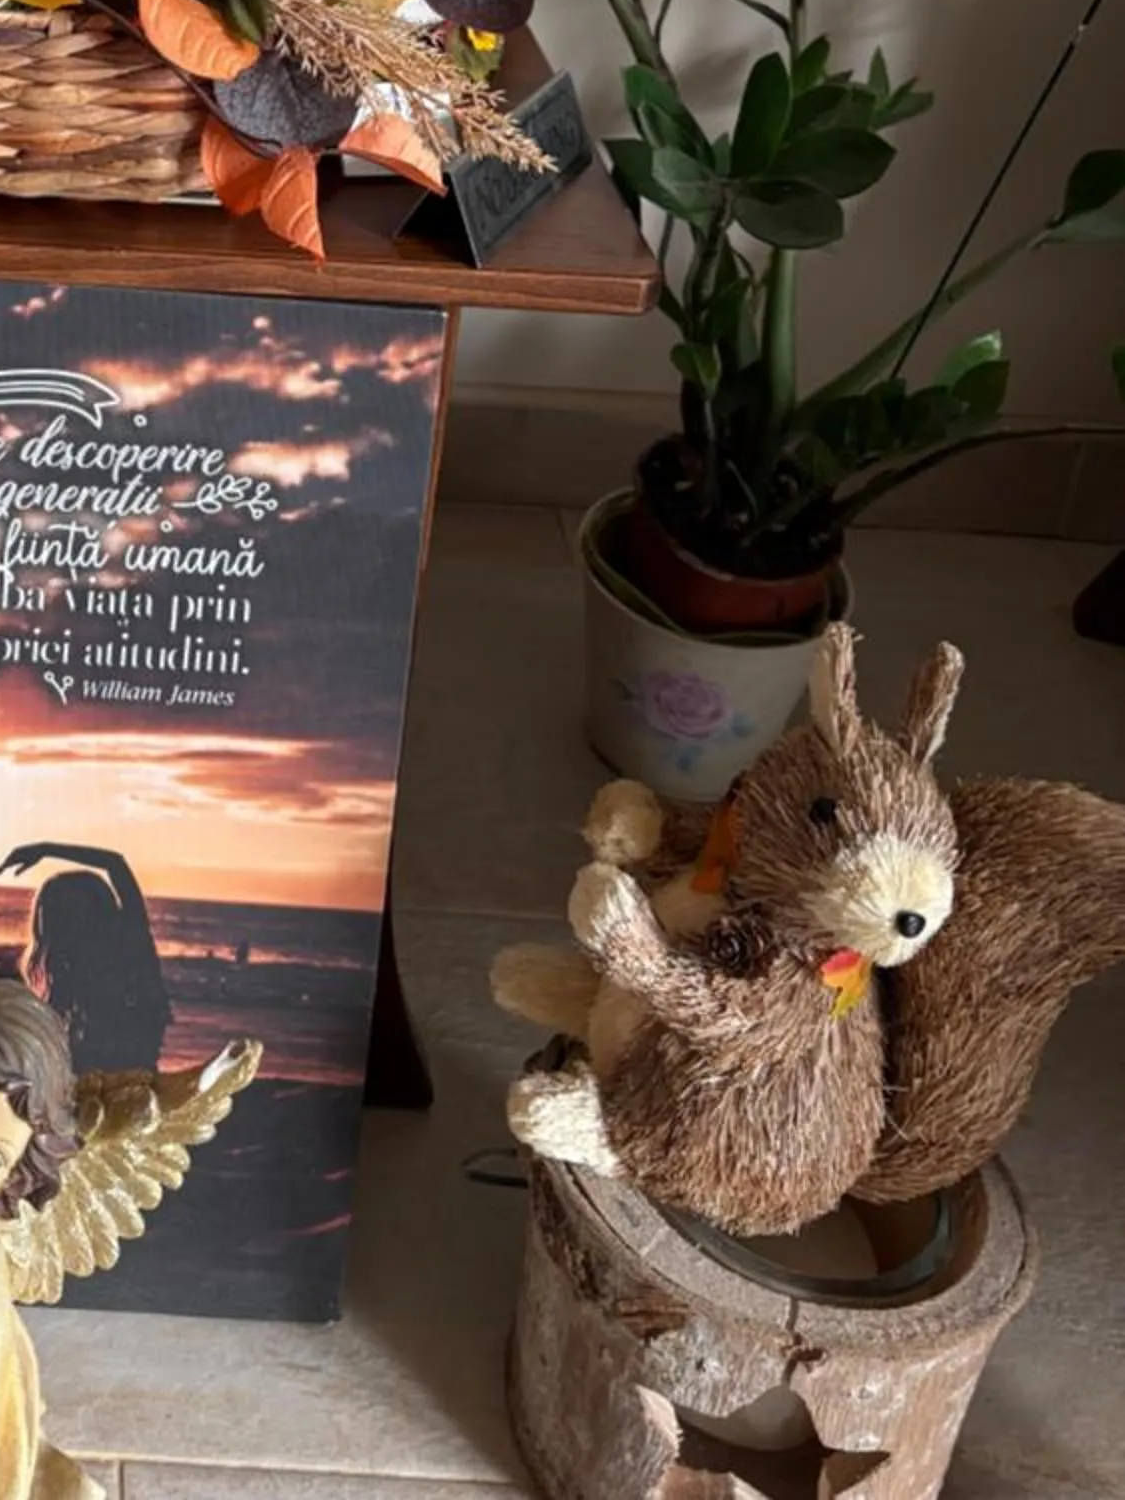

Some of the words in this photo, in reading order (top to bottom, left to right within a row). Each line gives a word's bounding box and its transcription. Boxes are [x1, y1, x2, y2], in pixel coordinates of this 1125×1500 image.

[19, 413, 226, 484] descoperire
[125, 537, 265, 578] umană
[169, 583, 253, 634] prin
[83, 630, 252, 677] atitudini.
[81, 678, 163, 703] William
[165, 682, 237, 708] James
